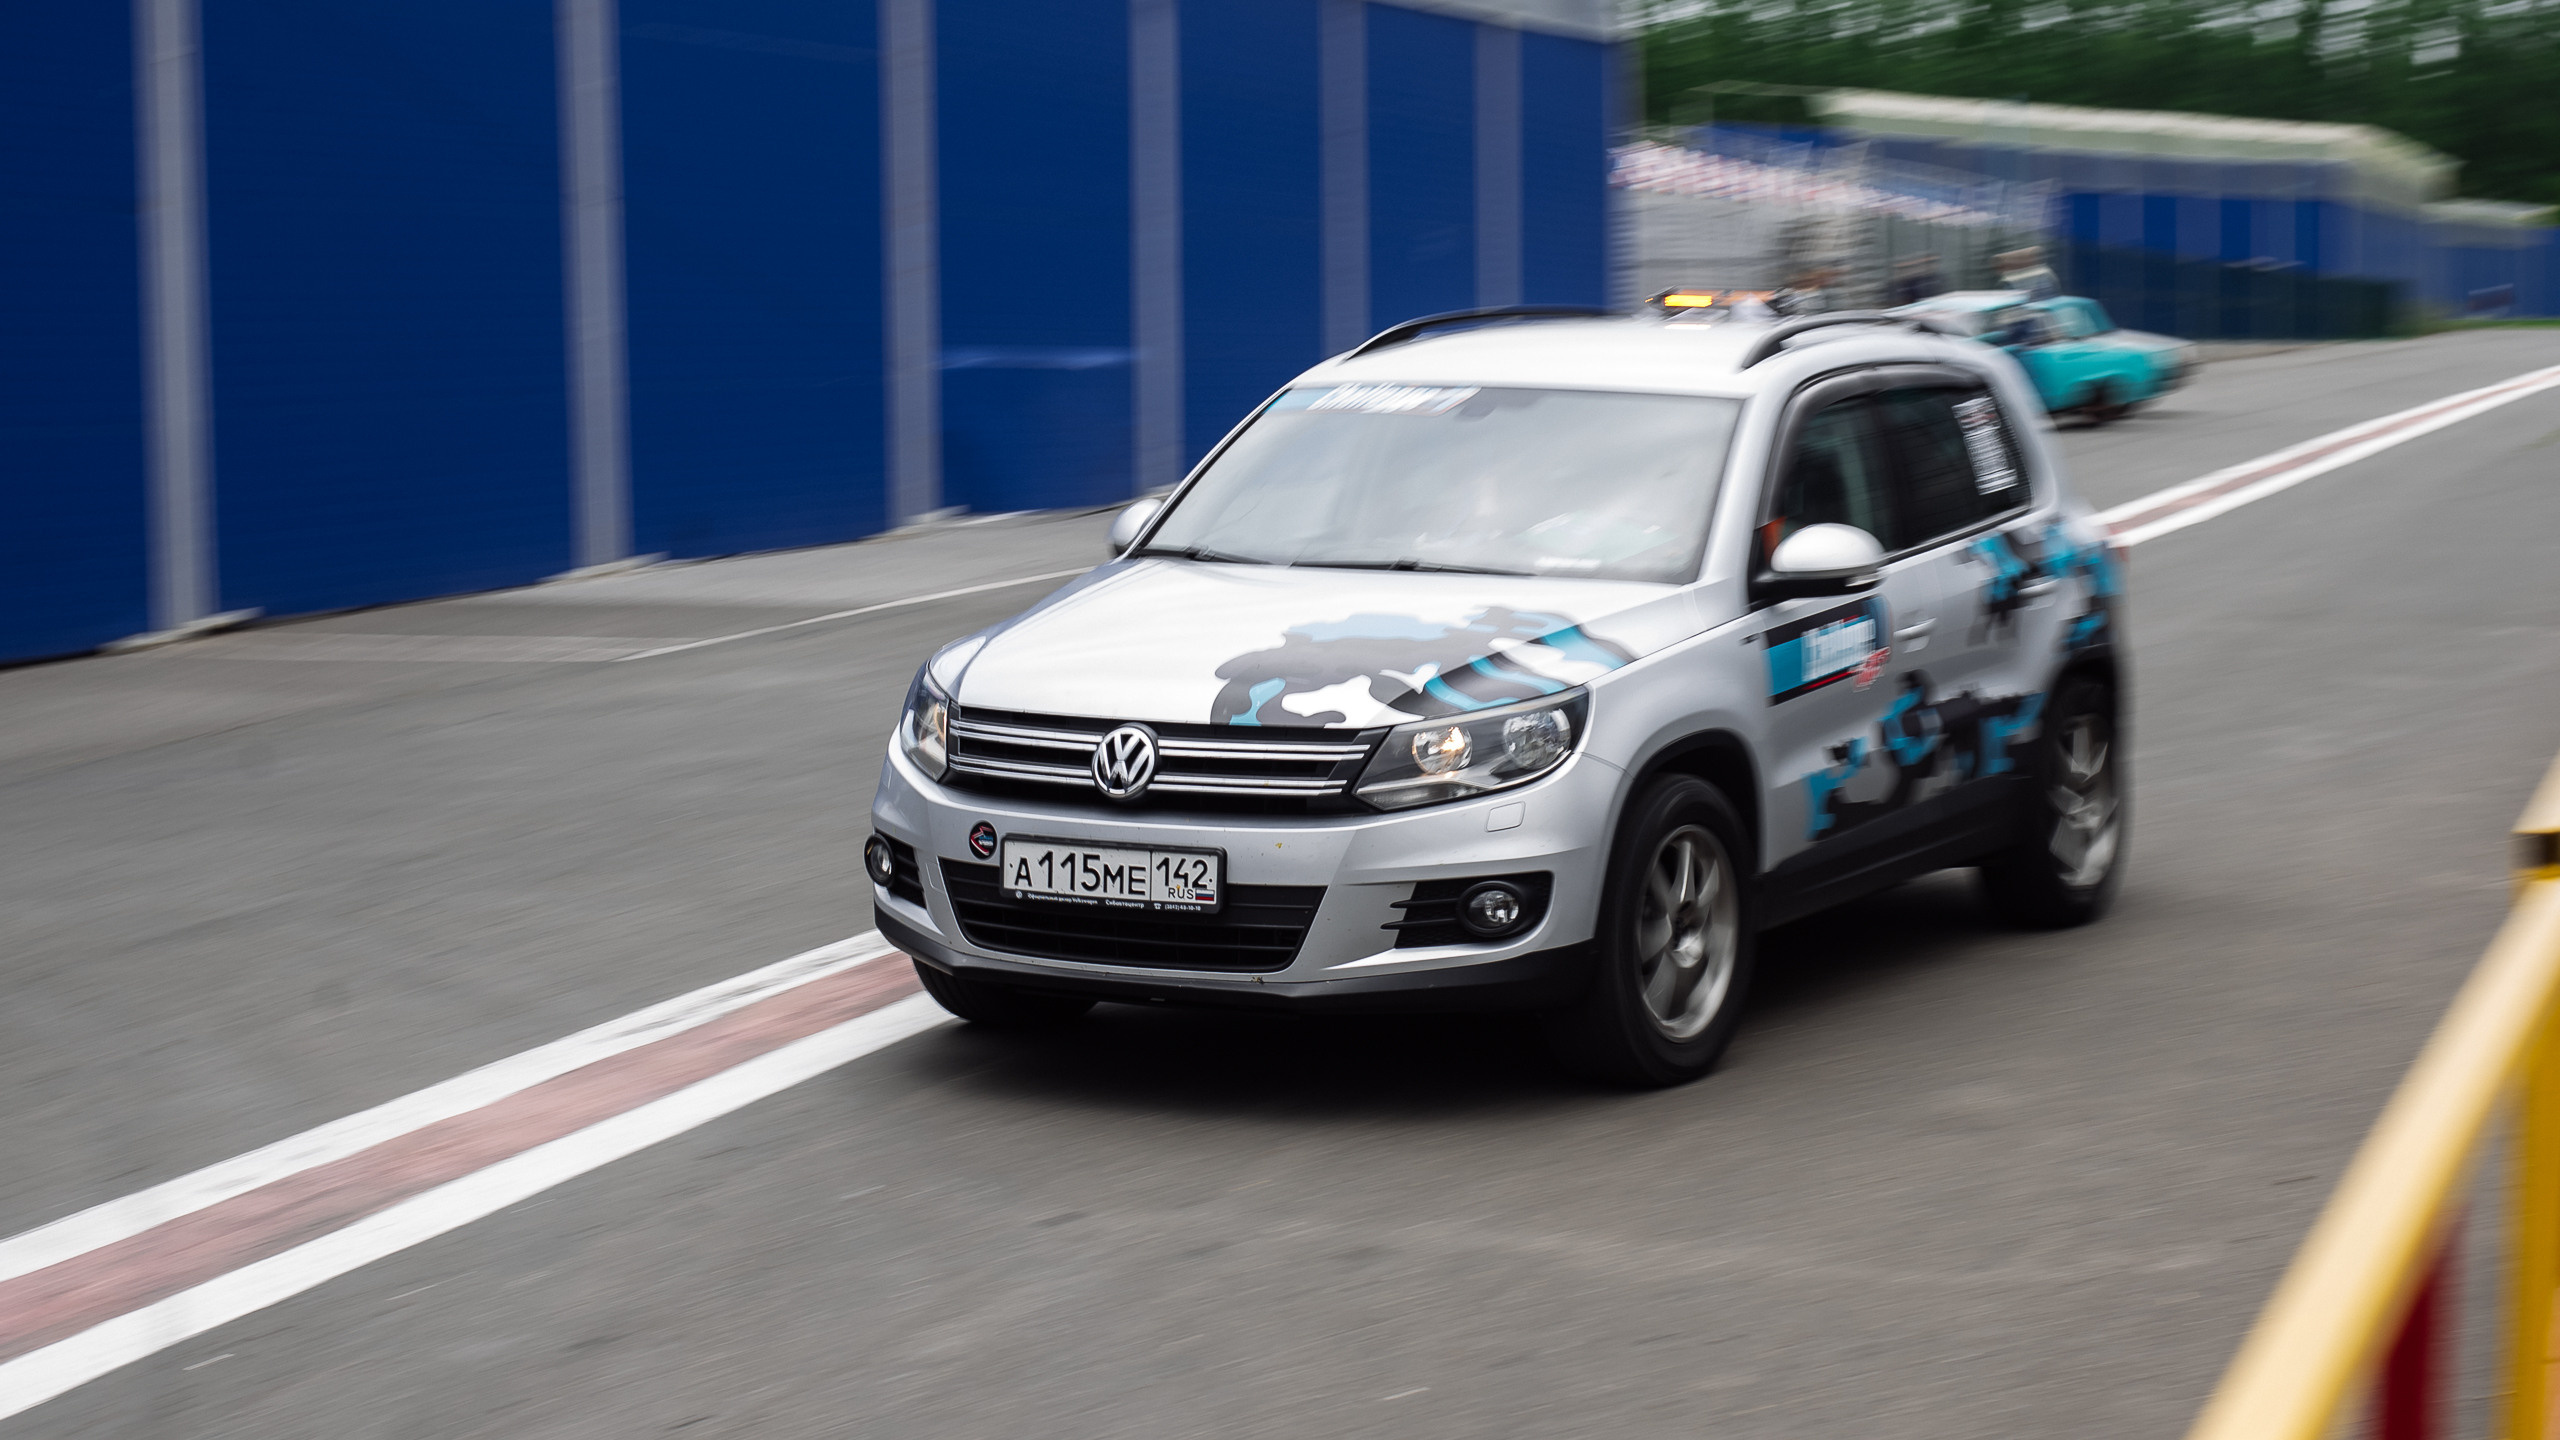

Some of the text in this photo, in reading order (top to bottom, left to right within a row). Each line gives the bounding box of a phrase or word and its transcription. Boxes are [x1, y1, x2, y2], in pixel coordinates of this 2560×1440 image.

[1095, 726, 1154, 795] VW
[1014, 850, 1209, 896] А115МЕ 142
[1168, 886, 1194, 900] RUS
